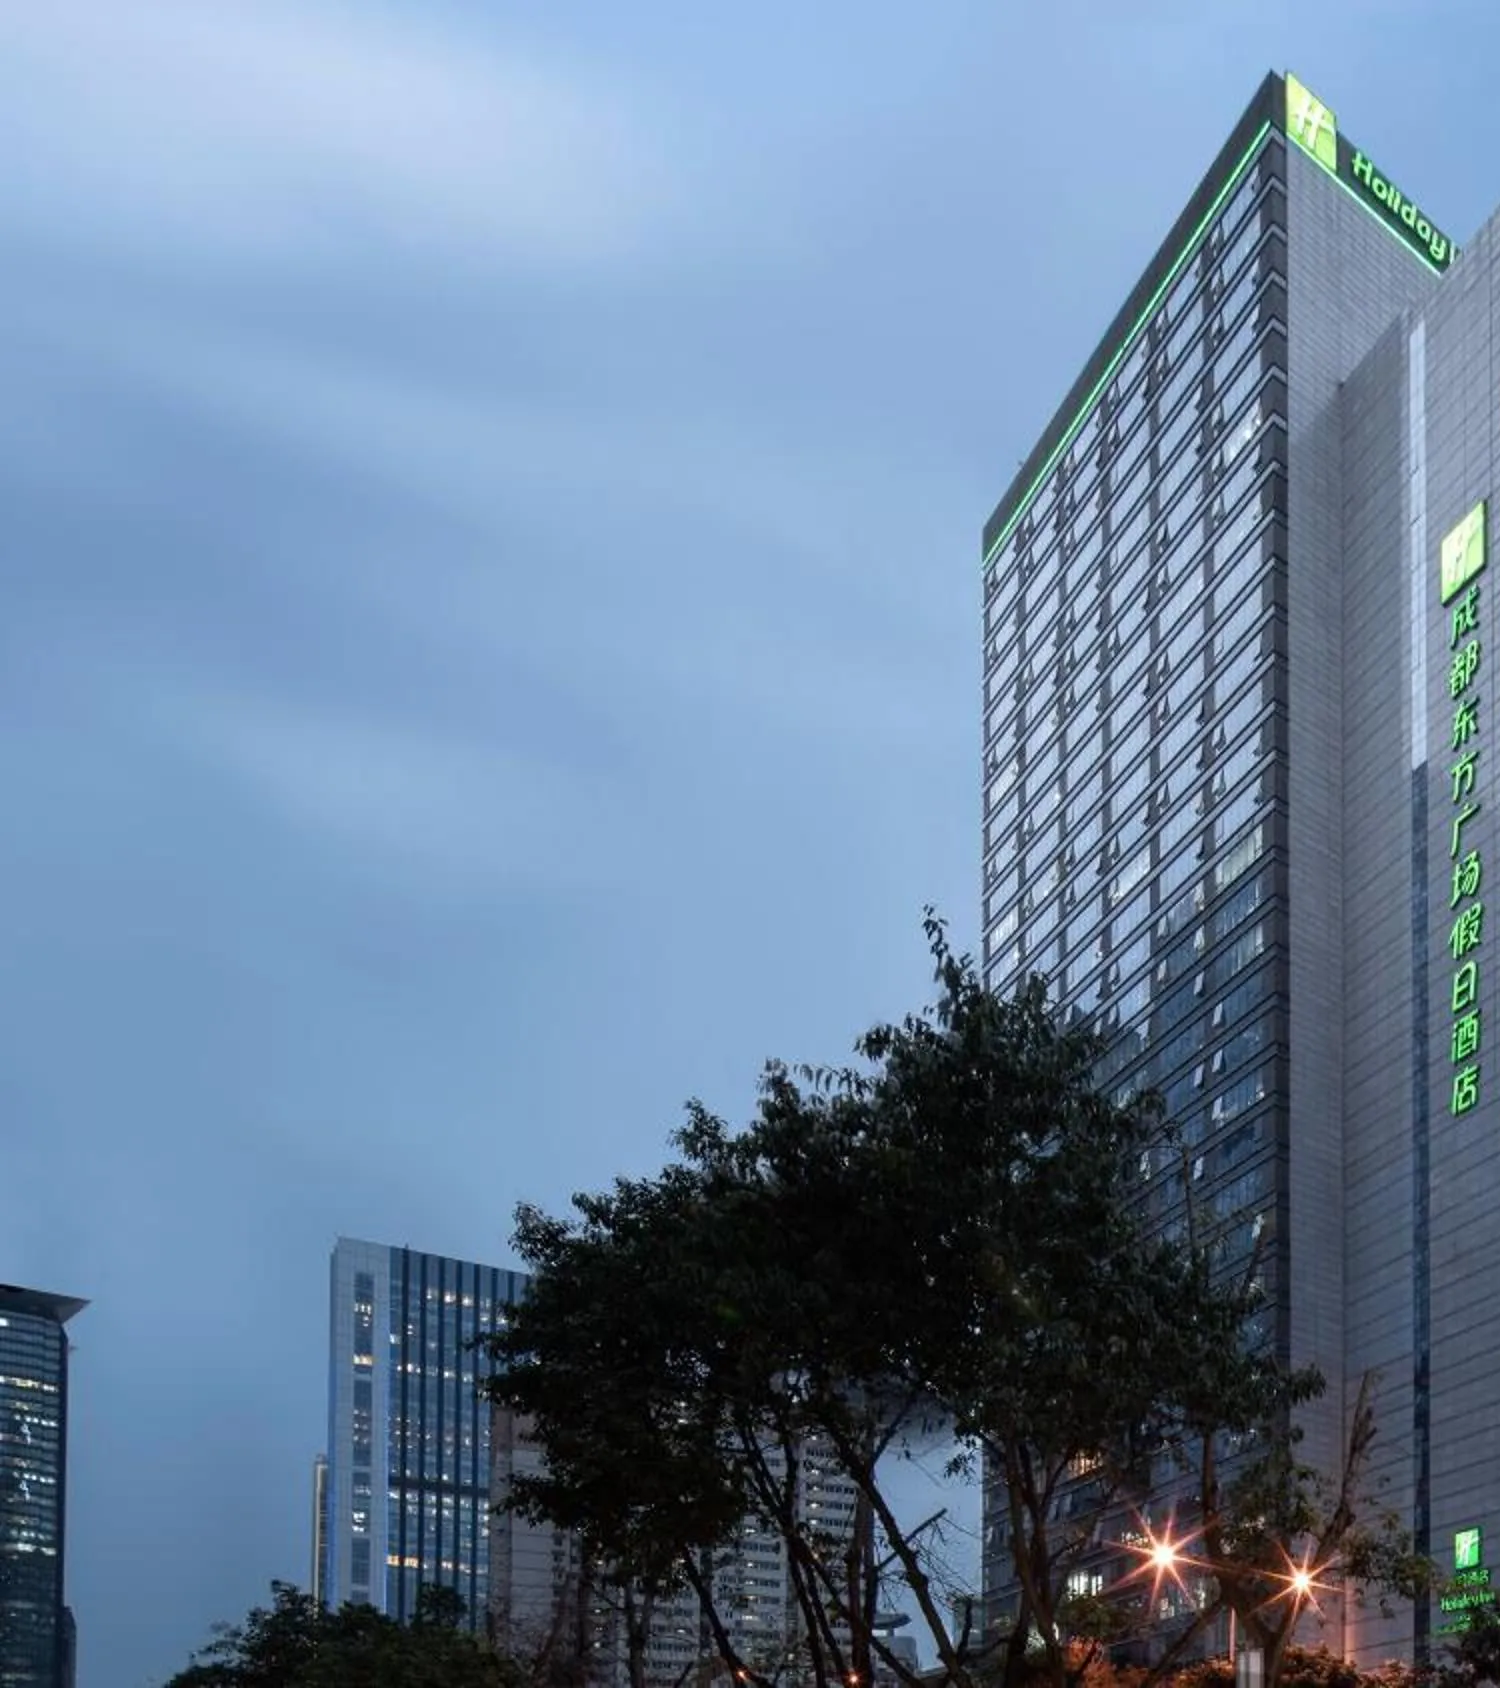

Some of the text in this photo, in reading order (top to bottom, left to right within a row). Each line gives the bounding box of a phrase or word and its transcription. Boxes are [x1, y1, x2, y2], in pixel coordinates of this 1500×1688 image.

[1352, 151, 1446, 261] Holiday
[1449, 583, 1482, 1116] 成都东方广场假日酒店
